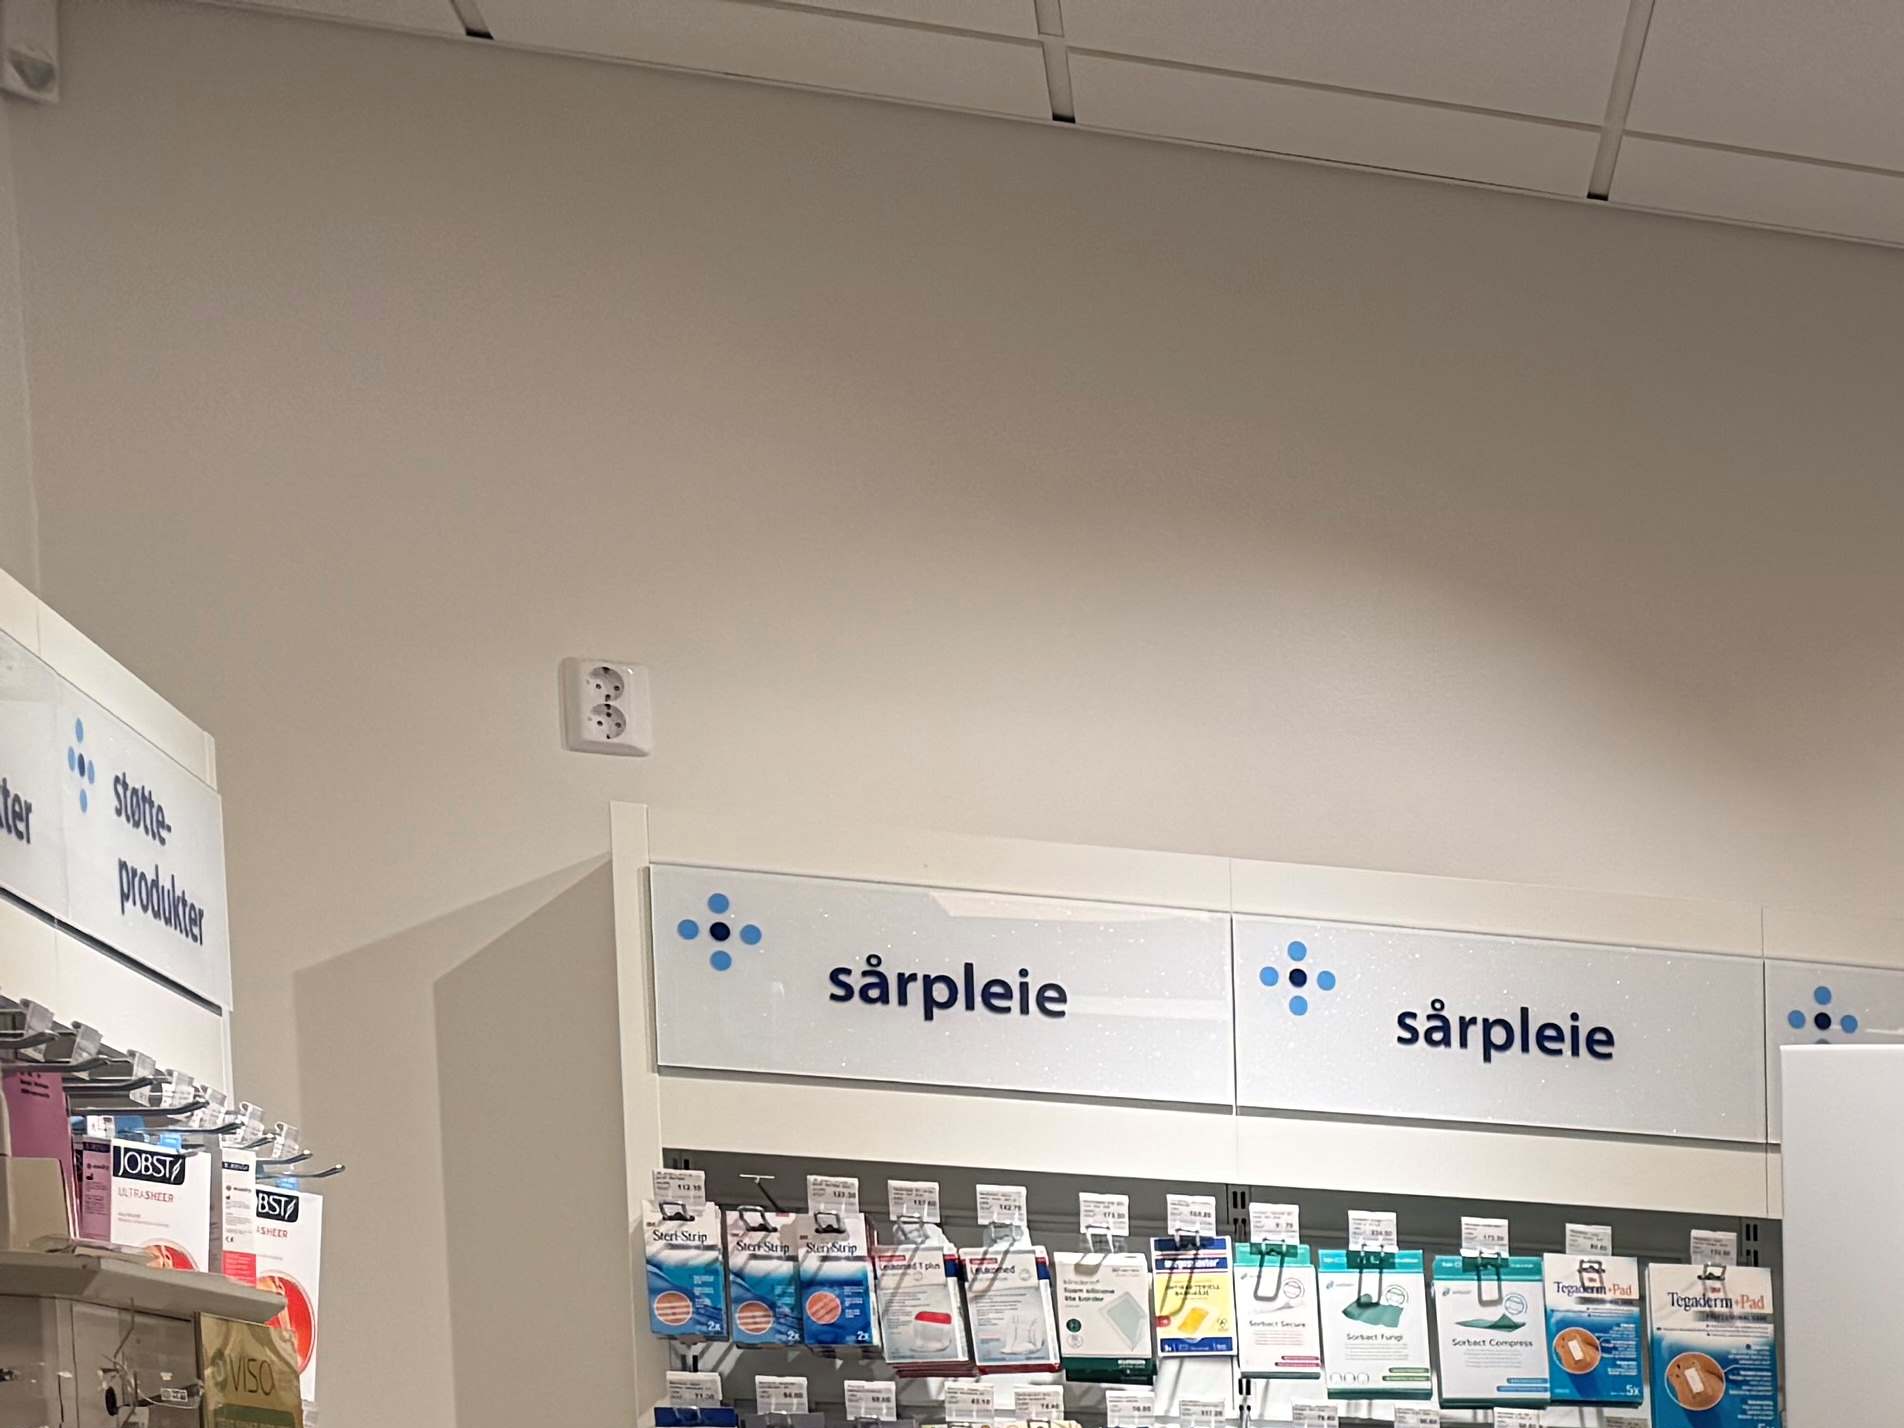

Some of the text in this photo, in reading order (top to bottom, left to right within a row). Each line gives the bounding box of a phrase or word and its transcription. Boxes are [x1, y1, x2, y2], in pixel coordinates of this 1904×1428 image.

[0, 777, 32, 844] ter
[113, 772, 171, 846] støtte-
[119, 858, 204, 946] produkter
[828, 955, 1068, 1021] sårpleie
[1396, 1002, 1616, 1063] sårpleie
[118, 1146, 173, 1181] JOBST
[118, 1188, 173, 1203] ULTRASHEER
[257, 1193, 288, 1219] BST
[653, 1230, 707, 1243] Steri-Strip
[1554, 1281, 1607, 1296] Tegaderm
[1668, 1292, 1732, 1310] Tegaderm
